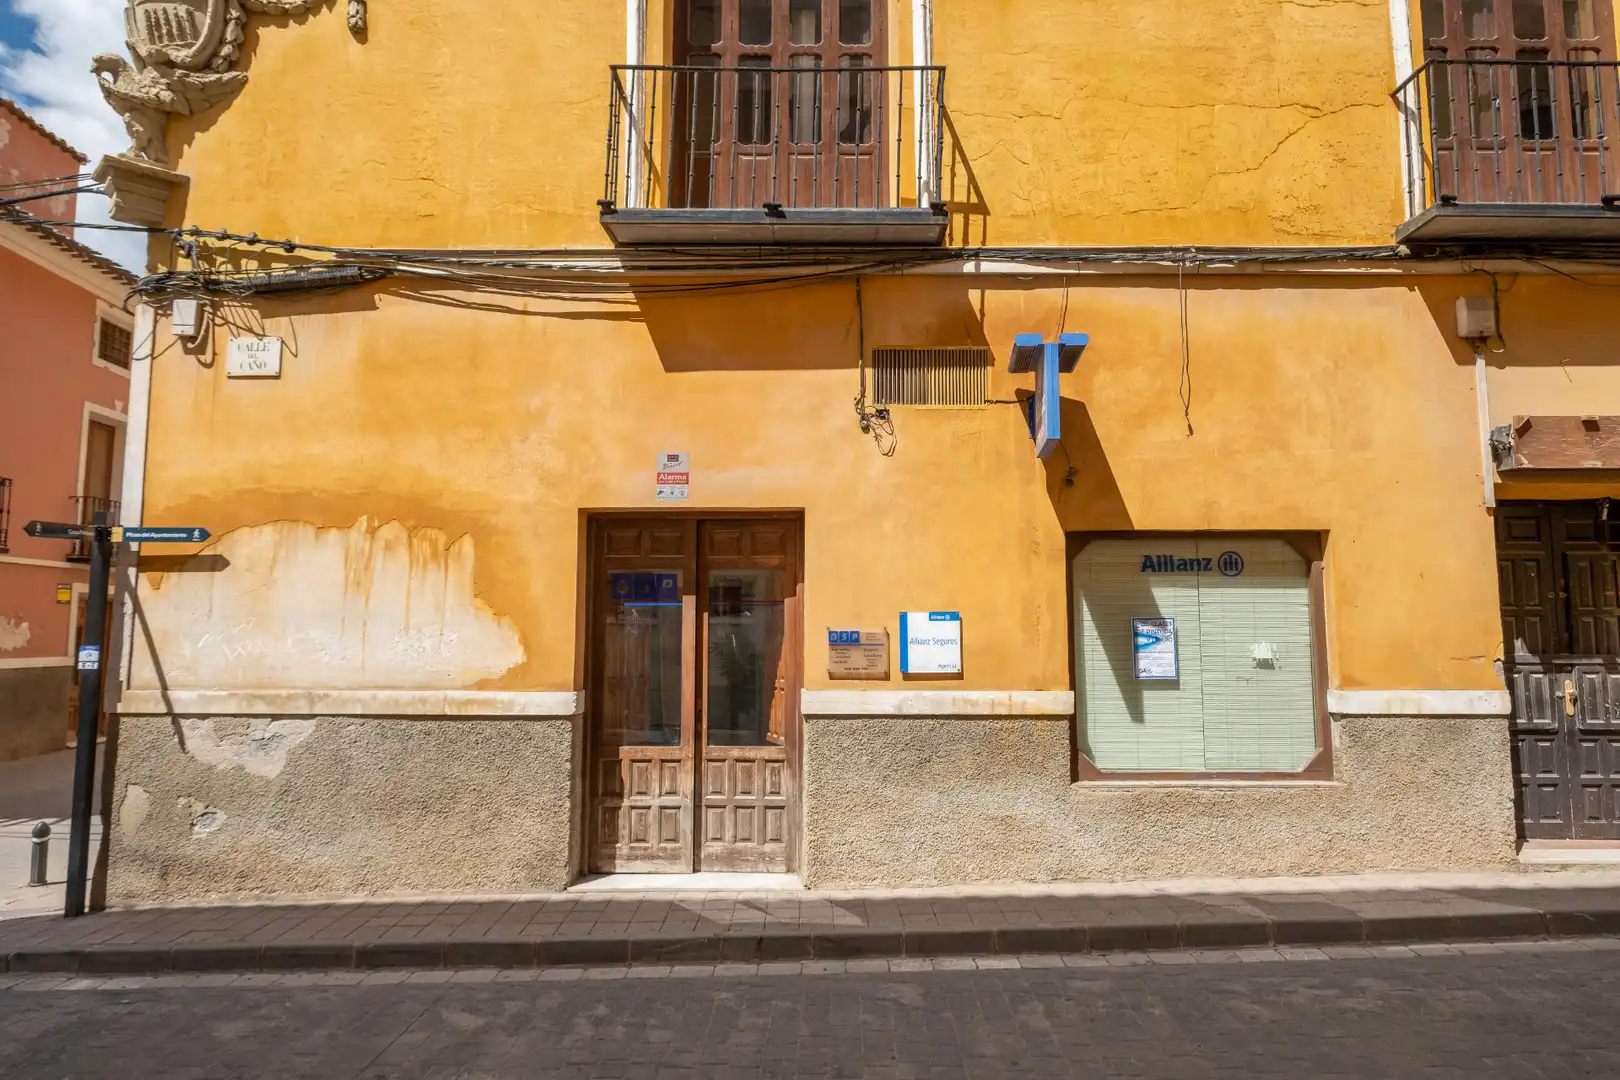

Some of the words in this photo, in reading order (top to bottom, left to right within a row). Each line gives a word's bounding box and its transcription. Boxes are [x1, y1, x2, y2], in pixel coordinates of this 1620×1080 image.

[237, 342, 270, 352] CALLE
[240, 359, 268, 370] CAÑO
[1140, 554, 1213, 573] Allianz
[910, 637, 930, 646] Allianz
[932, 637, 958, 647] Seguros
